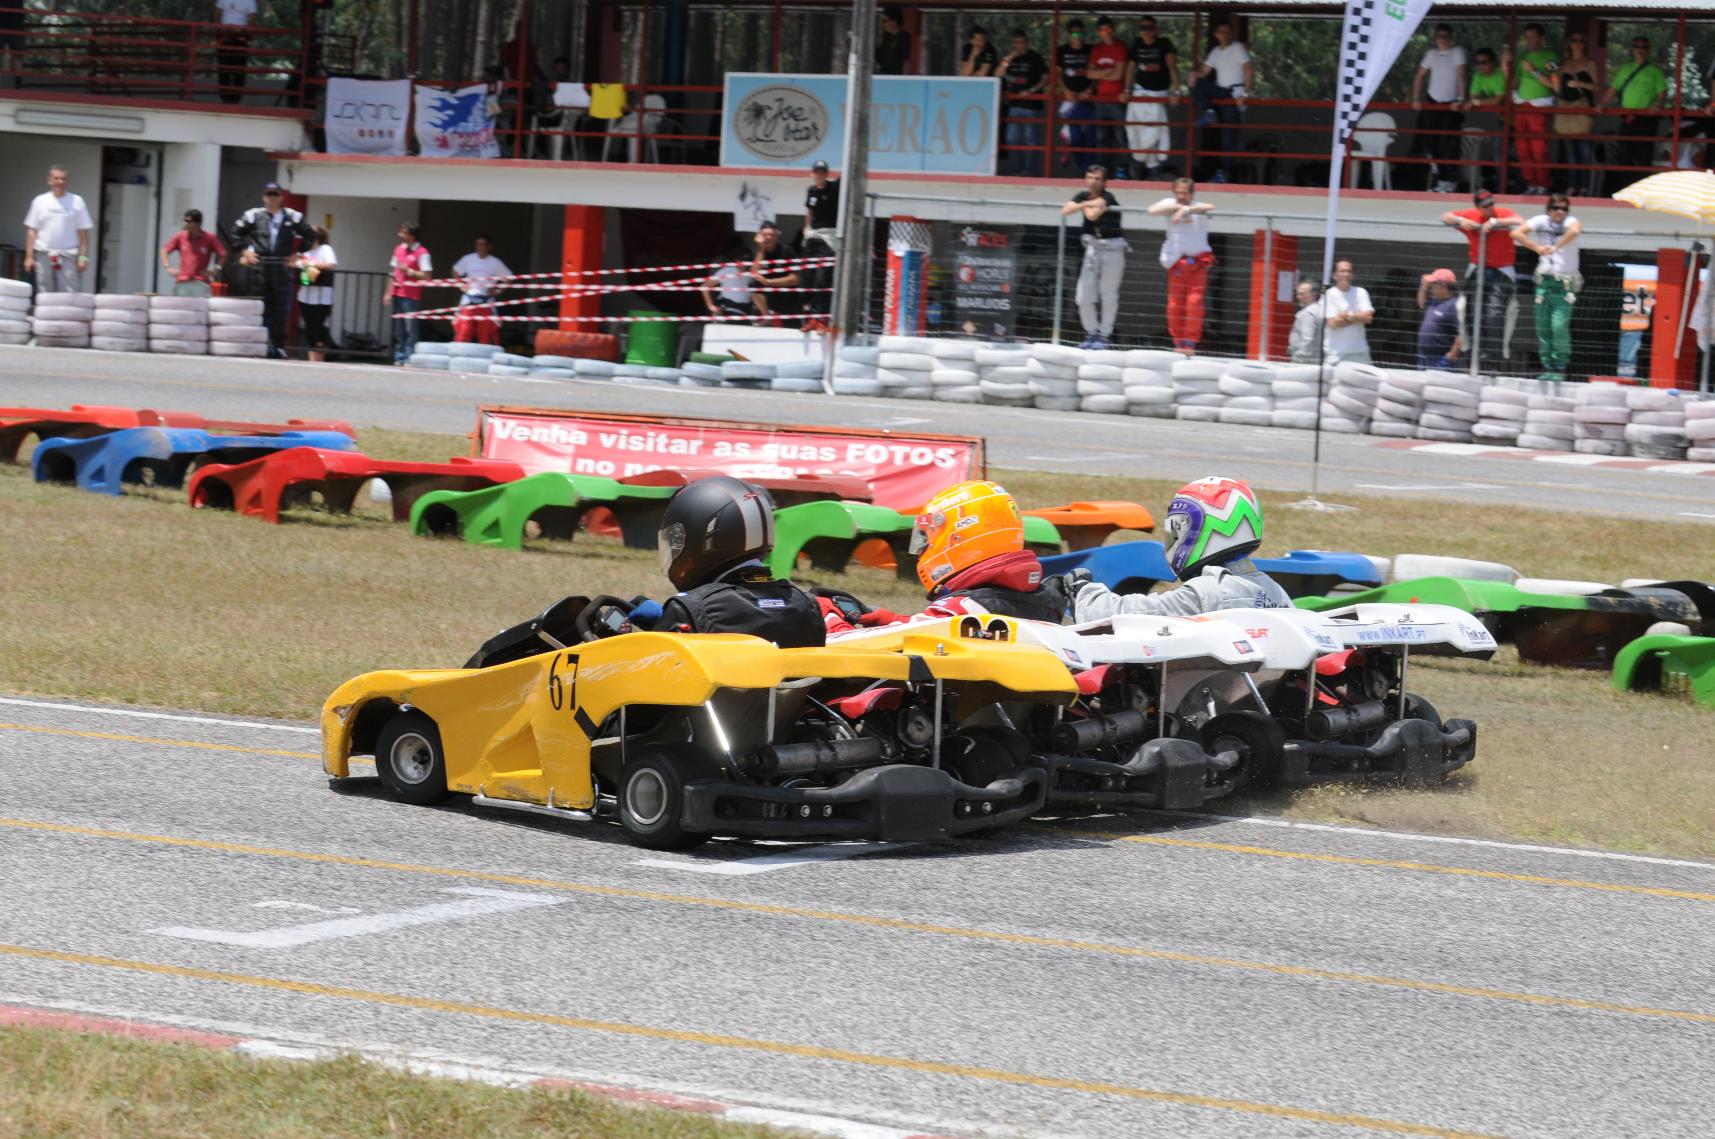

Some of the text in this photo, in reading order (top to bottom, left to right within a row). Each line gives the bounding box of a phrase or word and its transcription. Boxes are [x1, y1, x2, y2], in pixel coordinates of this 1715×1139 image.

[492, 418, 956, 468] Venha visitar as suas FOTOS
[575, 456, 616, 475] no
[549, 651, 580, 711] 67
